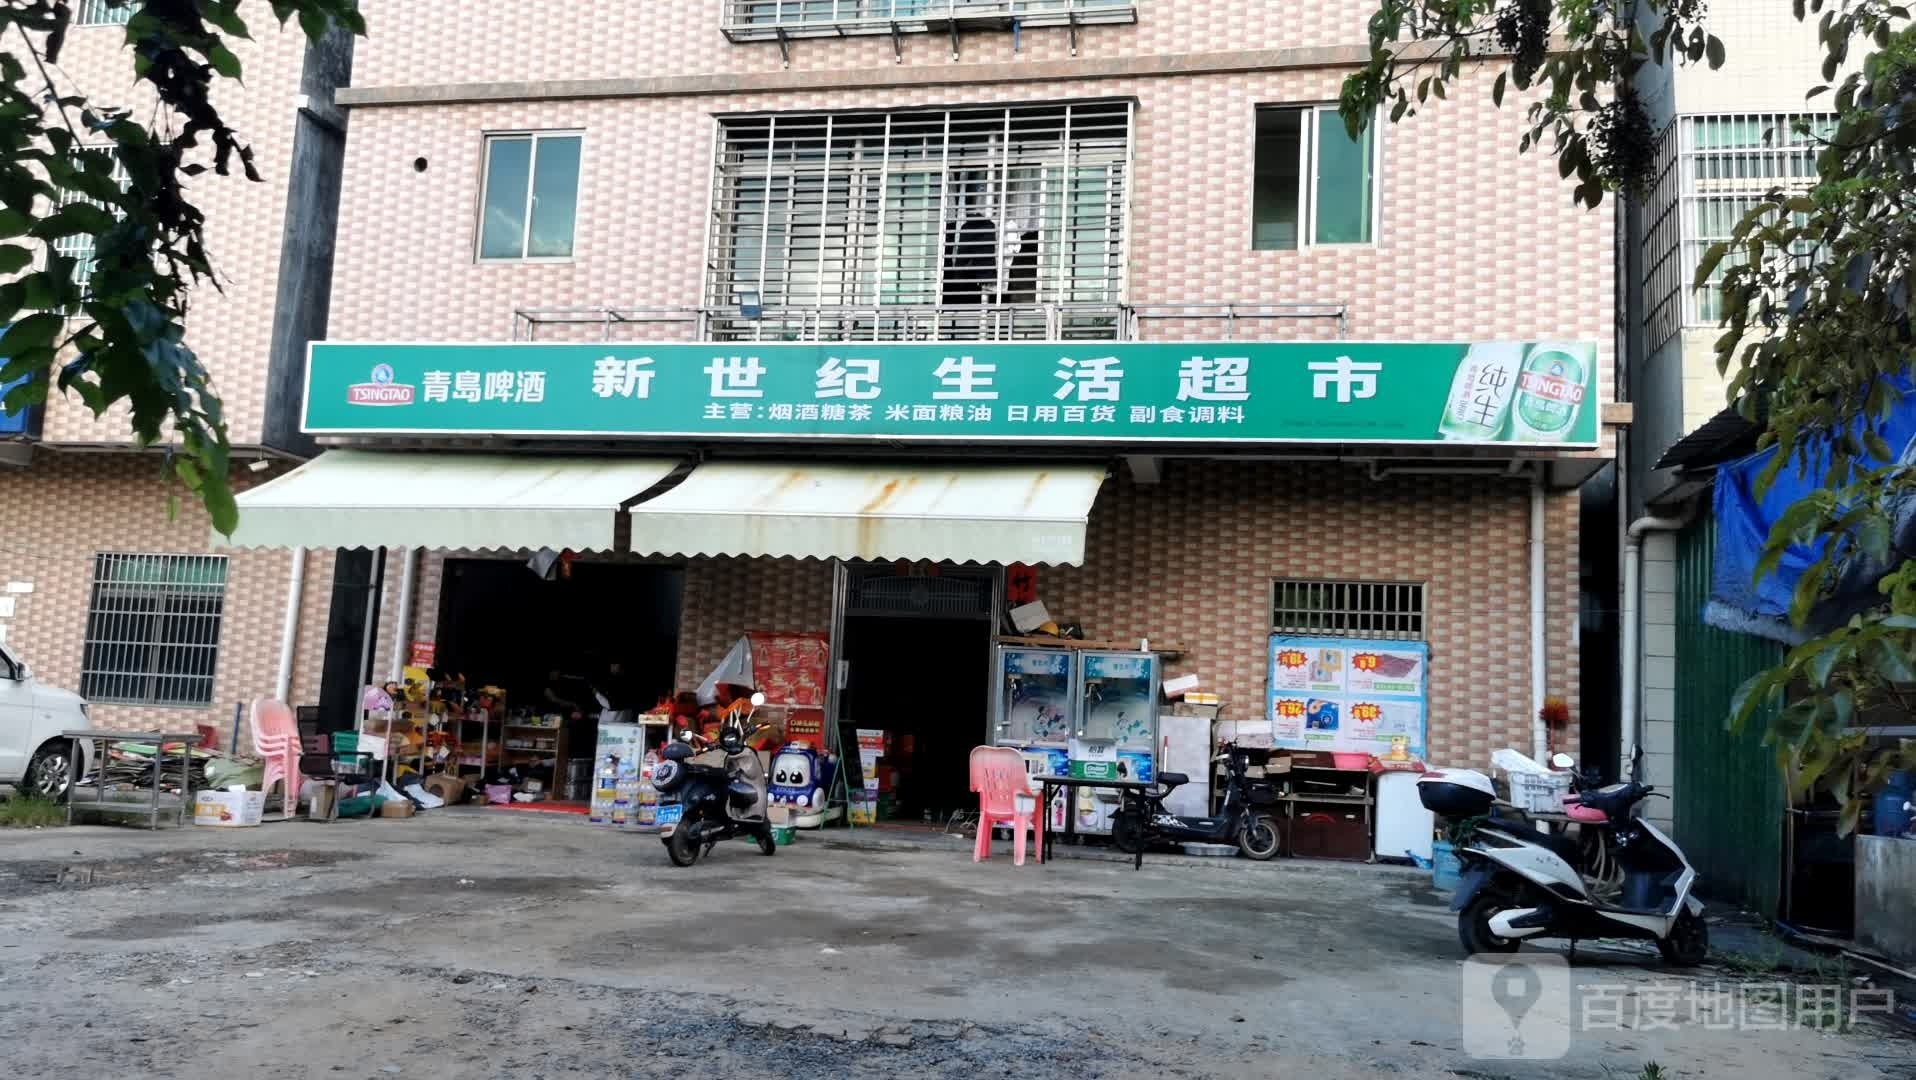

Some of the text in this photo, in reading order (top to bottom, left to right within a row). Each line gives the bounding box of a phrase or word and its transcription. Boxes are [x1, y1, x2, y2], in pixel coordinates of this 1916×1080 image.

[353, 387, 411, 402] TSINGTAO
[592, 355, 1383, 403] 新世纪生活超市
[1466, 363, 1509, 429] 纯生
[885, 403, 993, 423] 米面粮油
[1007, 405, 1117, 423] 日用百货
[1129, 405, 1246, 425] 副食调料
